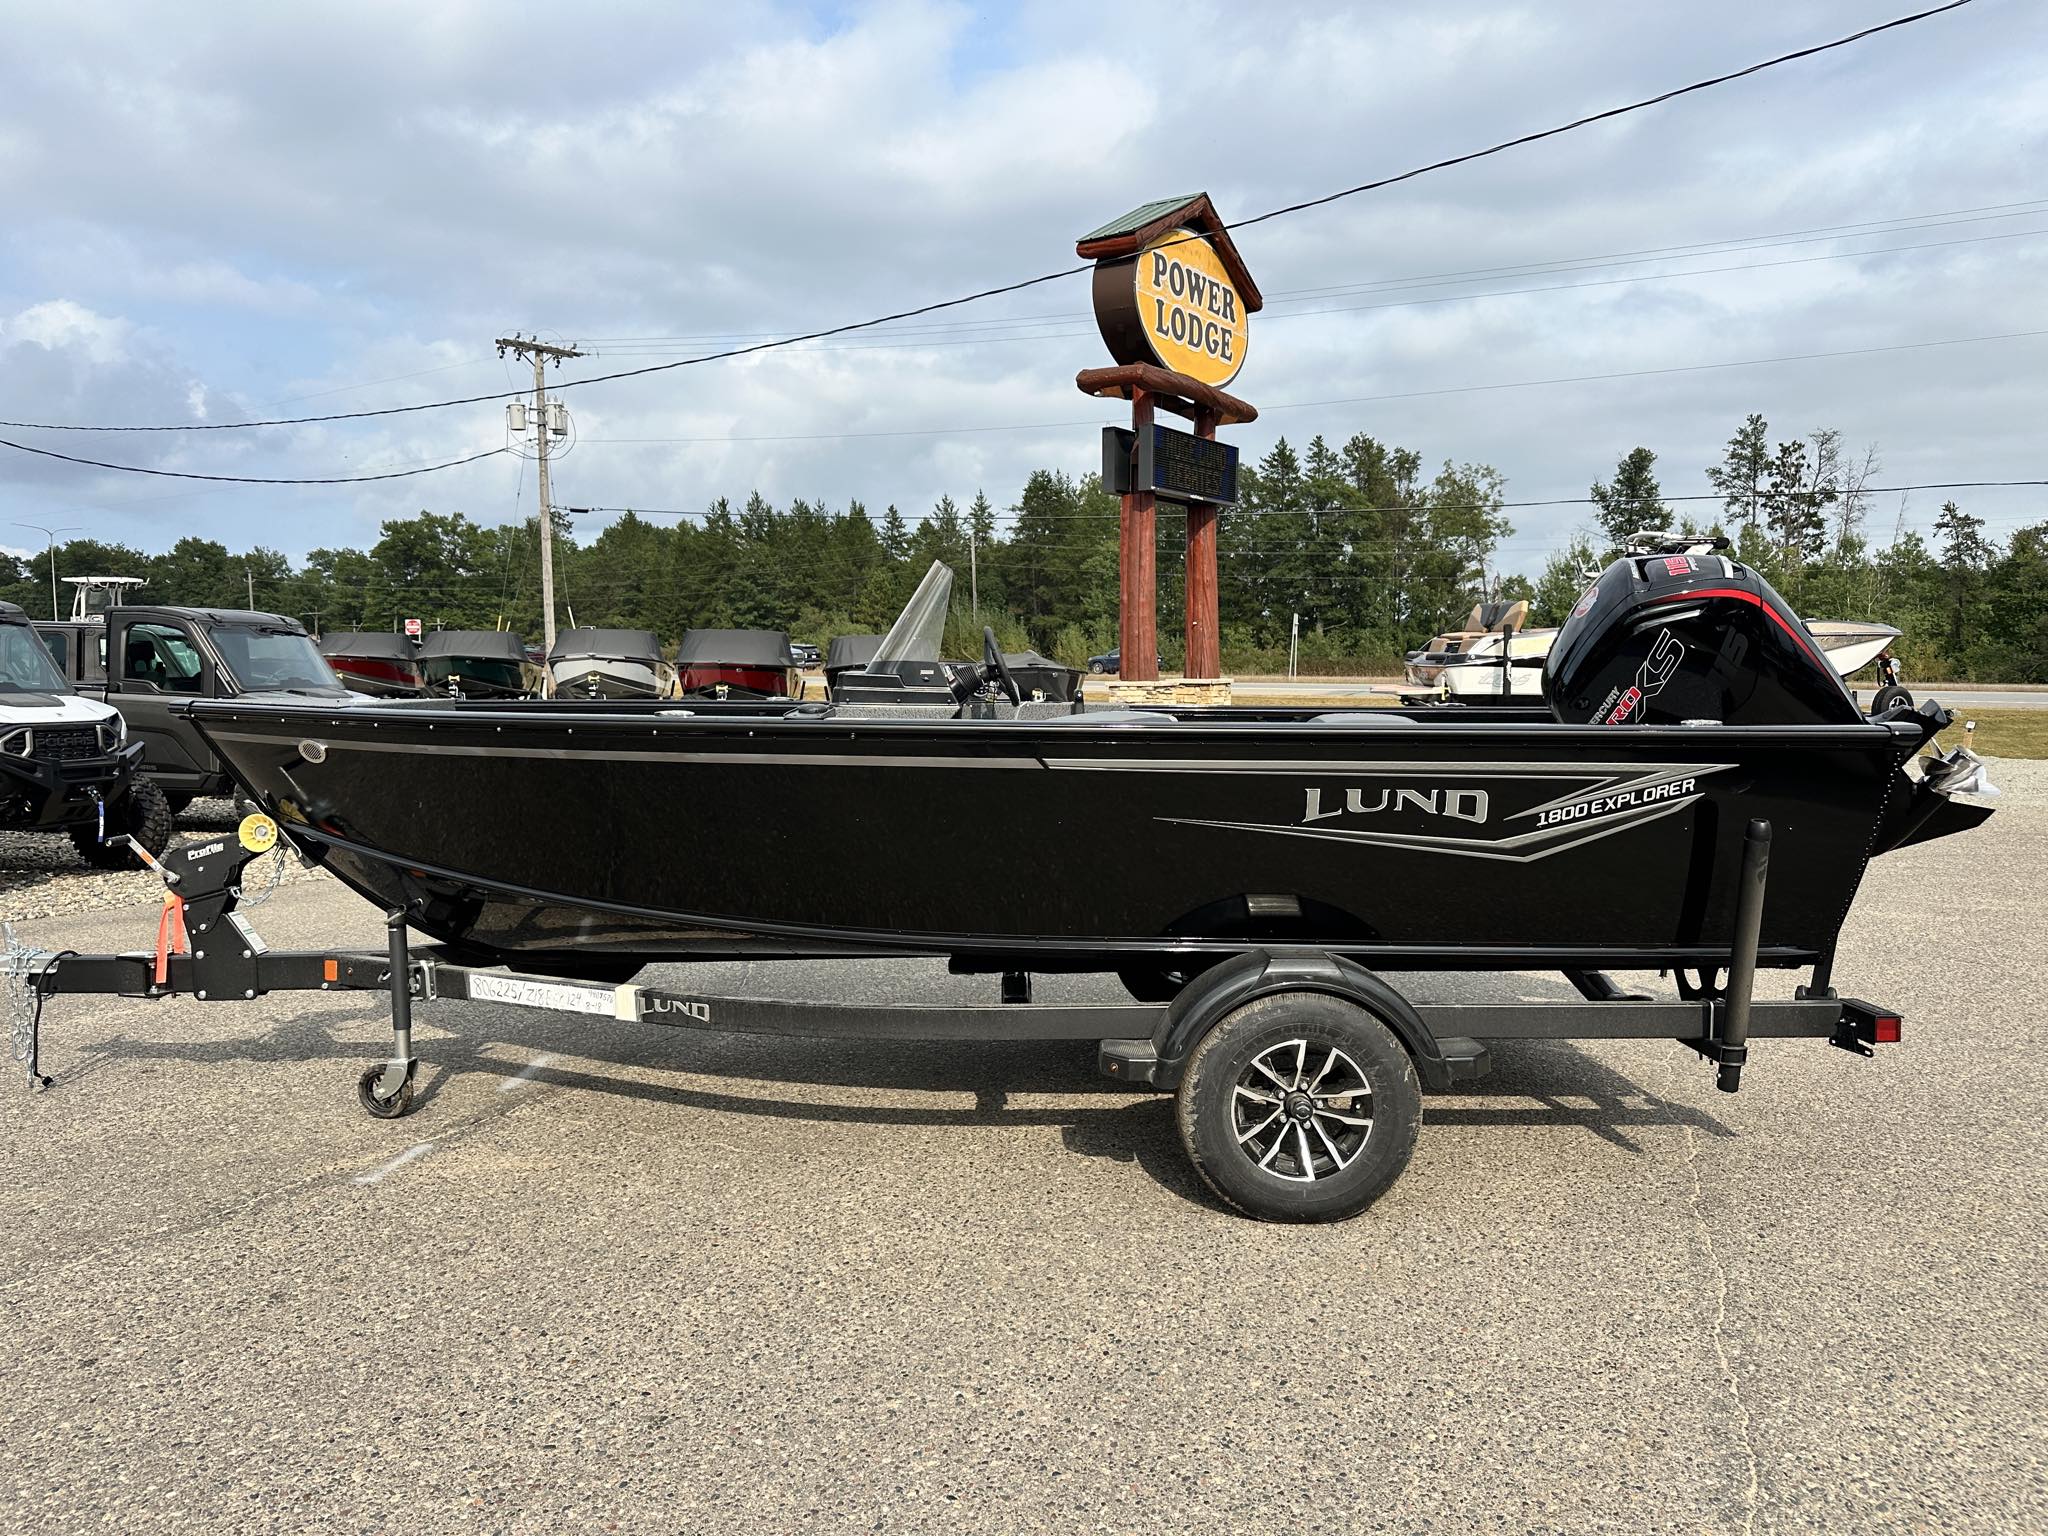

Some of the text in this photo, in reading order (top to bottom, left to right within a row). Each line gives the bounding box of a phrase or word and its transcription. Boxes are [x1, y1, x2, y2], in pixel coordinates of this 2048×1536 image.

[1152, 250, 1237, 325] POWER
[1154, 297, 1234, 363] LODGE
[1588, 685, 1621, 725] ERCURY
[35, 735, 96, 748] POLARIS
[1301, 788, 1490, 824] LUND
[1536, 777, 1696, 827] 1800 EXPLORER
[637, 996, 711, 1024] LUND
